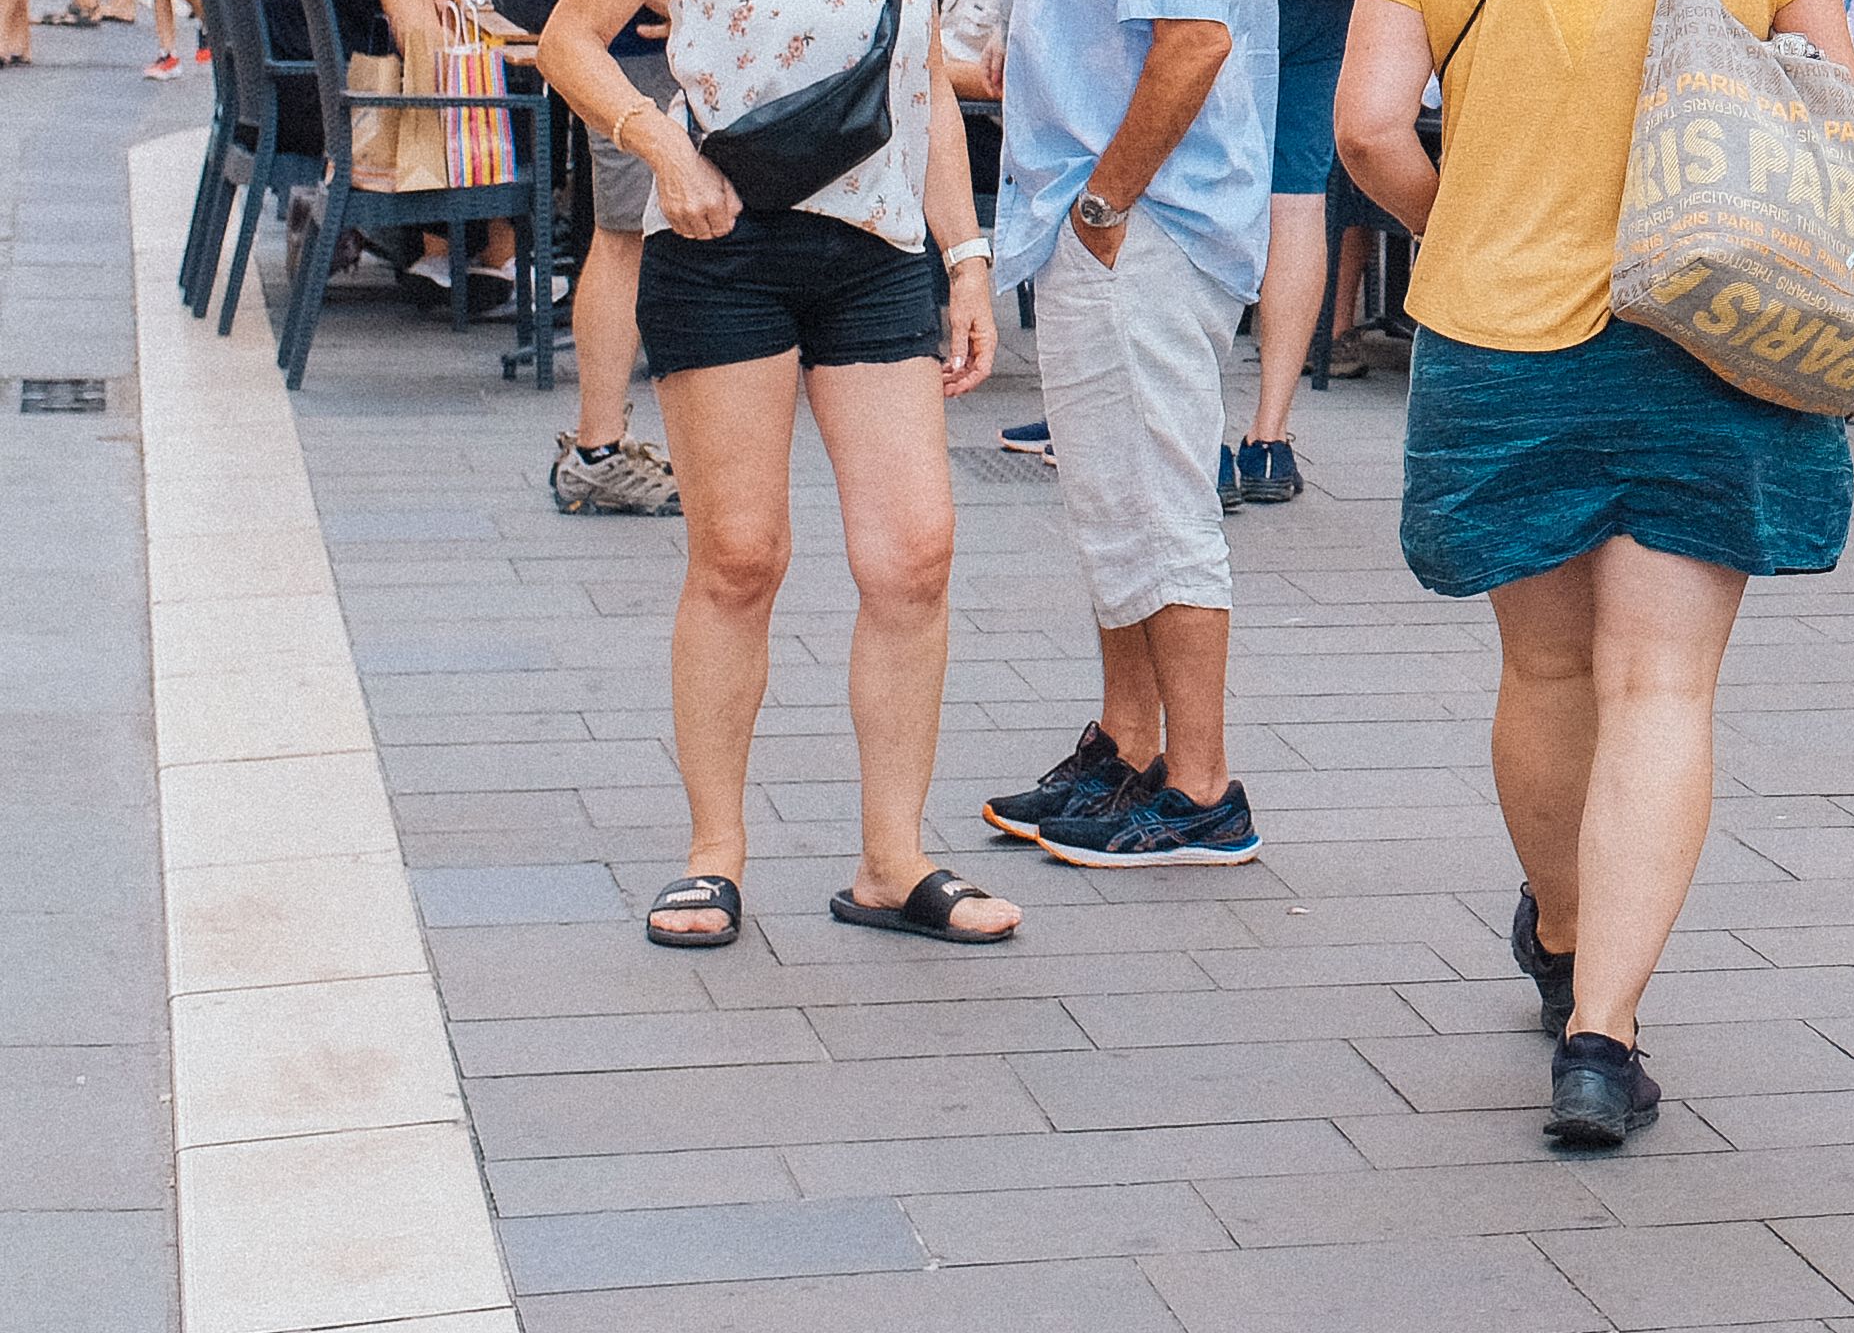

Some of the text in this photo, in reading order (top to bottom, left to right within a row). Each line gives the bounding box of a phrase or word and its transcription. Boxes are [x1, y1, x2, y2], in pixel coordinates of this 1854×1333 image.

[1676, 70, 1751, 102] PARIS
[1716, 213, 1764, 238] PARIS
[1770, 228, 1812, 258] PARIS
